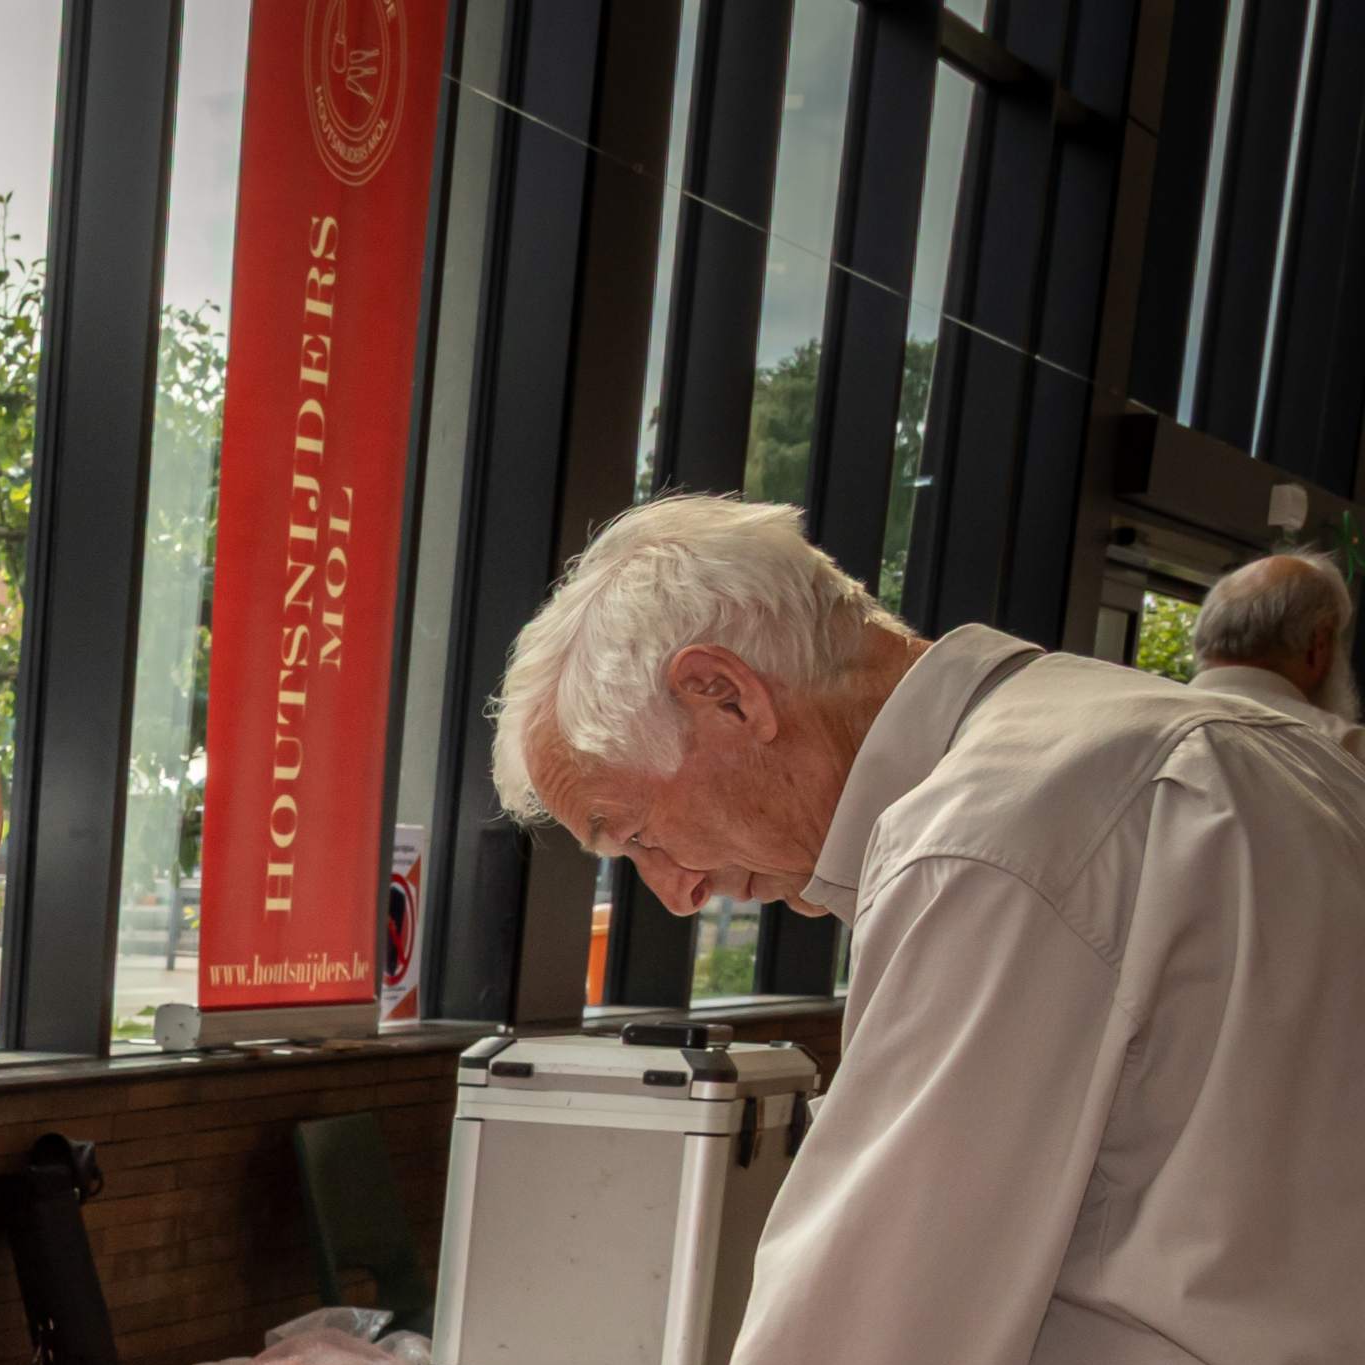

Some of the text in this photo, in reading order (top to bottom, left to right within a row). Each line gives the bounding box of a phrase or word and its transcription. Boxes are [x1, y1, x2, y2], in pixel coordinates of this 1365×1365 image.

[265, 216, 339, 922] HOUTSNIJDERS
[319, 486, 354, 672] MOL
[209, 952, 369, 992] www.houtsnijders.be
